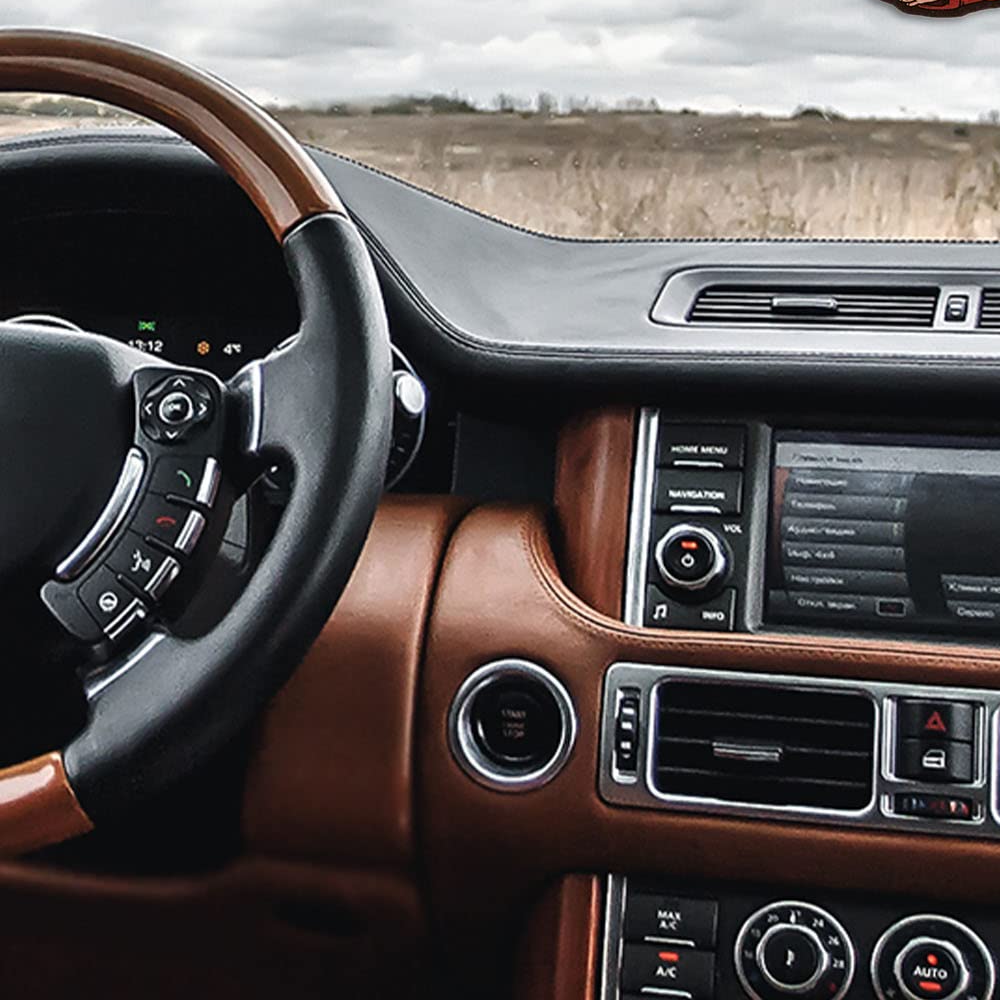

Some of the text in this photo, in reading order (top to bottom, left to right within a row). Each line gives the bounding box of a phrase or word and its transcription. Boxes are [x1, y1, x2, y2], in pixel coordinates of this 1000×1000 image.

[671, 445, 728, 455] HOME MENU
[668, 489, 726, 500] NAVIGATION
[723, 523, 743, 534] VOL
[702, 611, 725, 621] INFO
[657, 910, 682, 921] MAX
[659, 920, 677, 930] A/C
[655, 966, 677, 978] A/C
[914, 966, 948, 979] AUTO
